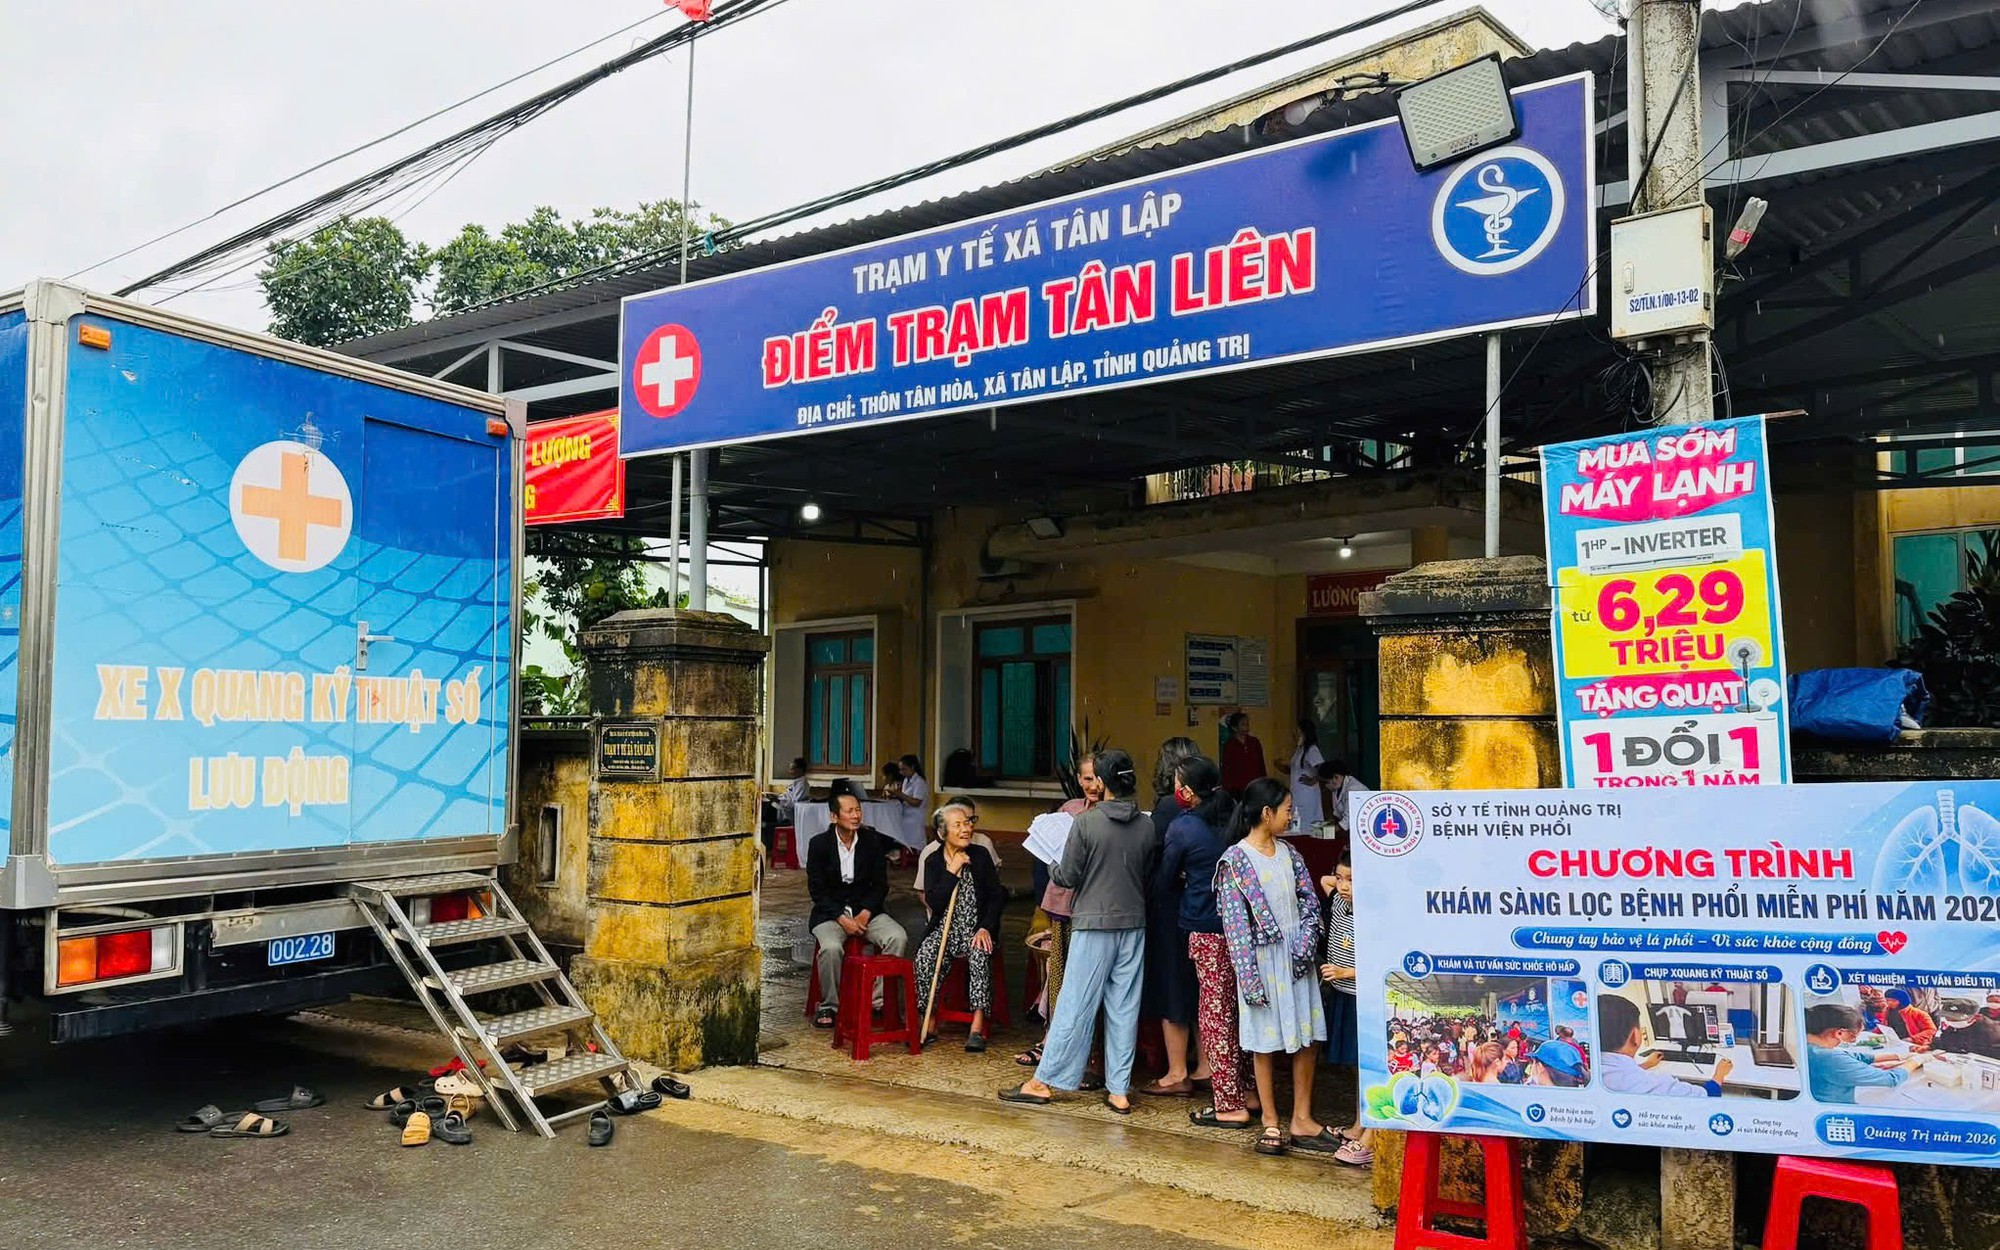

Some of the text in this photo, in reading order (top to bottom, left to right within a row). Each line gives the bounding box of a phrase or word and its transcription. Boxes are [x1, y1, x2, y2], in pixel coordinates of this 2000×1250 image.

[853, 190, 1182, 294] TRẠM Y TẾ XÃ TÂN LẬP
[762, 226, 1316, 388] ĐIỂM TRẠM TÂN LIÊN
[797, 333, 1250, 427] ĐỊA CHỈ: THÔN TÂN HÒA, XÃ TÂN LẬP, TỈNH QUẢNG TRỊ
[531, 434, 591, 468] LƯỢNG
[1577, 426, 1737, 474] MUA SỚM
[1560, 462, 1754, 513] MÁY LẠNH
[1625, 526, 1726, 555] INVERTER
[1572, 570, 1744, 637] từ 6,29
[1609, 629, 1725, 670] TRIỆU
[93, 664, 483, 733] XE X QUANG KỸ THUẬT SỐ
[1576, 680, 1744, 718] TẶNG QUẠT
[1584, 720, 1760, 773] 1 ĐỔI 1
[188, 745, 349, 816] LƯU ĐỘNG
[1593, 769, 1760, 788] TRONG 1 NĂM
[1457, 805, 1466, 817] Y
[1472, 801, 1490, 816] TẾ
[1597, 804, 1621, 818] TRỊ
[1432, 821, 1478, 840] BỆNH
[1484, 821, 1524, 839] VIỆN
[1528, 841, 1854, 879] CHƯƠNG TRÌNH
[1426, 883, 2000, 922] KHÁM SÀNG LỌC BỆNH PHỔI MIỄN PHÍ NĂM 202
[271, 934, 333, 963] 002.28
[1532, 931, 1574, 948] Chung
[1578, 934, 1598, 948] tay
[1602, 933, 1625, 945] bảo
[1629, 934, 1643, 947] vệ
[1647, 933, 1660, 945] lá
[1663, 932, 1694, 949] phổi
[1711, 934, 1731, 947] Vì
[1734, 935, 1759, 948] sức
[1763, 935, 1796, 949] khỏe
[1801, 938, 1833, 952] cộng
[1838, 936, 1872, 953] đồng
[1438, 958, 1575, 972] KHÁM VÀ TƯ VẤN SỨC KHỎE HÔ HẤP
[1644, 967, 1769, 981] CHỤP XQUANG KỸ THUẬT SỐ
[1848, 972, 1865, 983] XÉT
[1868, 973, 1905, 987] NGHIỆM
[1916, 974, 1930, 985] TƯ
[1931, 973, 1951, 985] VẤN
[1954, 974, 1978, 987] ĐIỀU
[1979, 976, 1996, 989] TRỊ
[1864, 1126, 1996, 1145] Quảng Trị năm 2026
